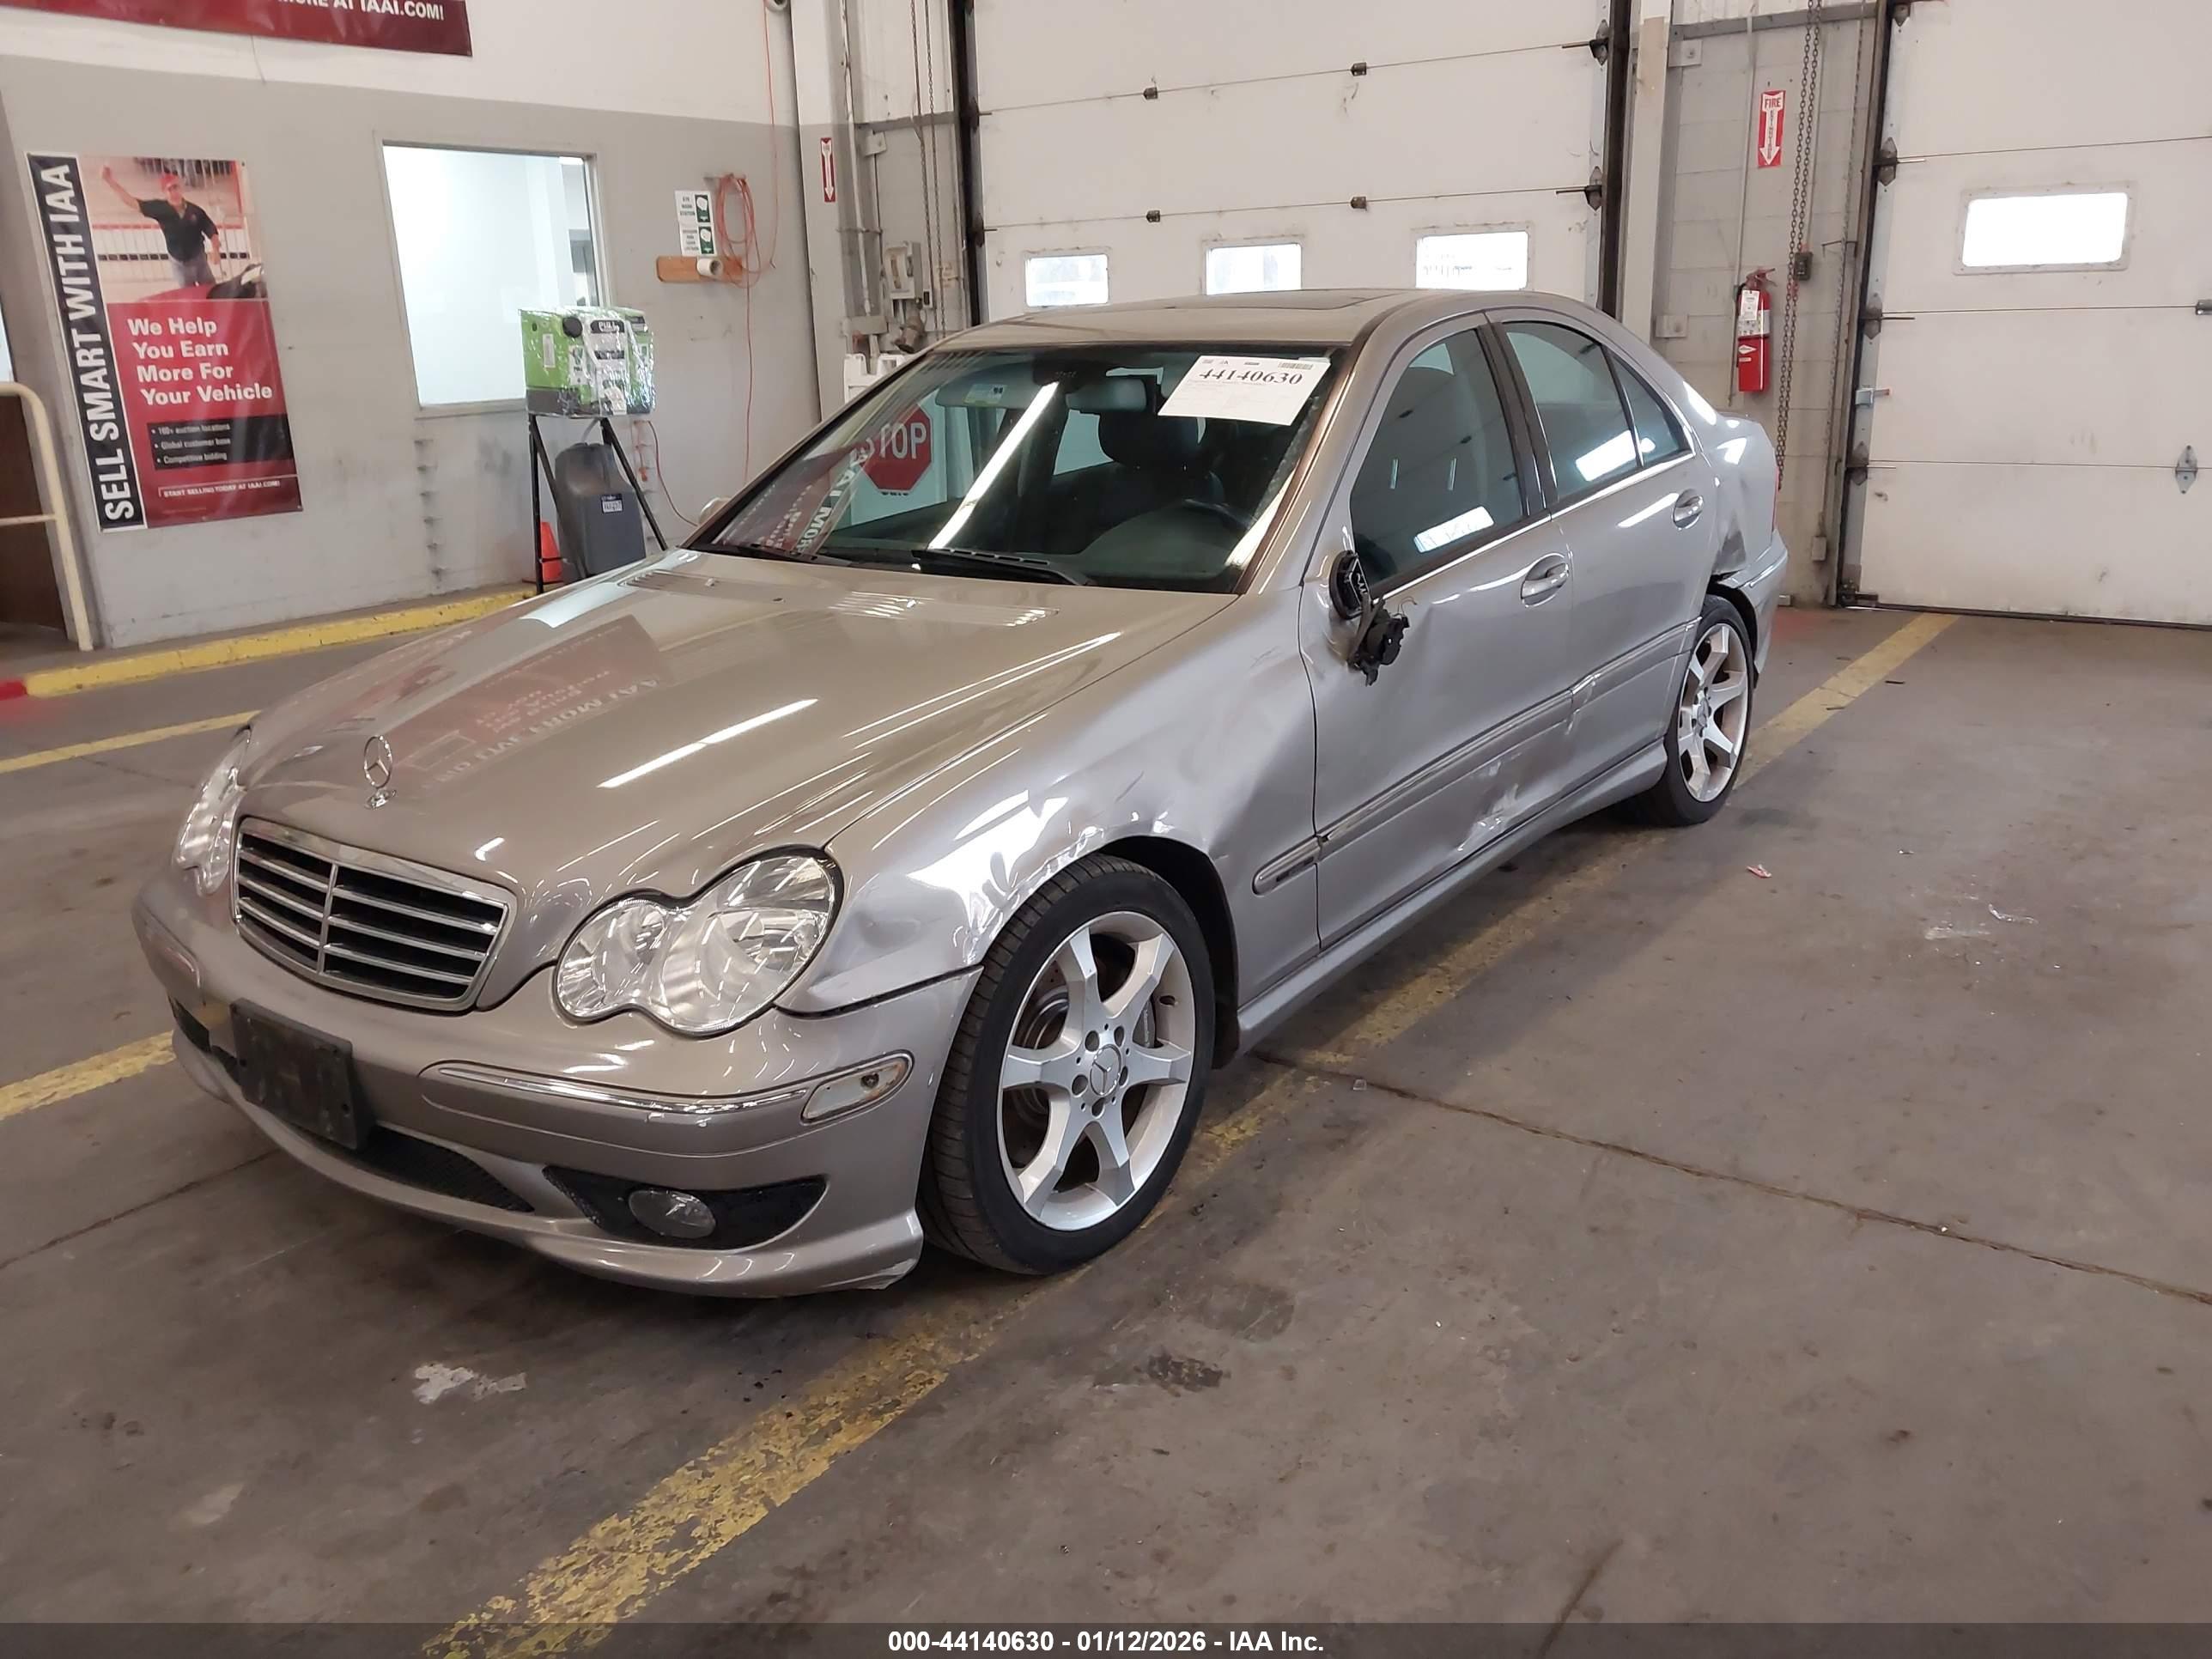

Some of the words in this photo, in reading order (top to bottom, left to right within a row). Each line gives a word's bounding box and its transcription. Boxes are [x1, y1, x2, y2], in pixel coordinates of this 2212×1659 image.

[361, 0, 444, 21] IAAI.COM!
[1765, 97, 1782, 108] FIRE
[41, 164, 80, 222] IAA
[52, 234, 97, 321] WITH
[127, 319, 162, 336] We
[168, 317, 217, 337] Help
[132, 341, 173, 359] You
[179, 340, 228, 357] Earn
[137, 365, 193, 383] More
[199, 362, 234, 380] For
[1199, 368, 1304, 385] 44140630
[71, 328, 119, 441] SMART
[141, 388, 191, 405] Your
[197, 383, 273, 403] Vehicle
[95, 448, 135, 521] SELL
[187, 487, 215, 495] SELLING
[215, 483, 236, 493] TODAY
